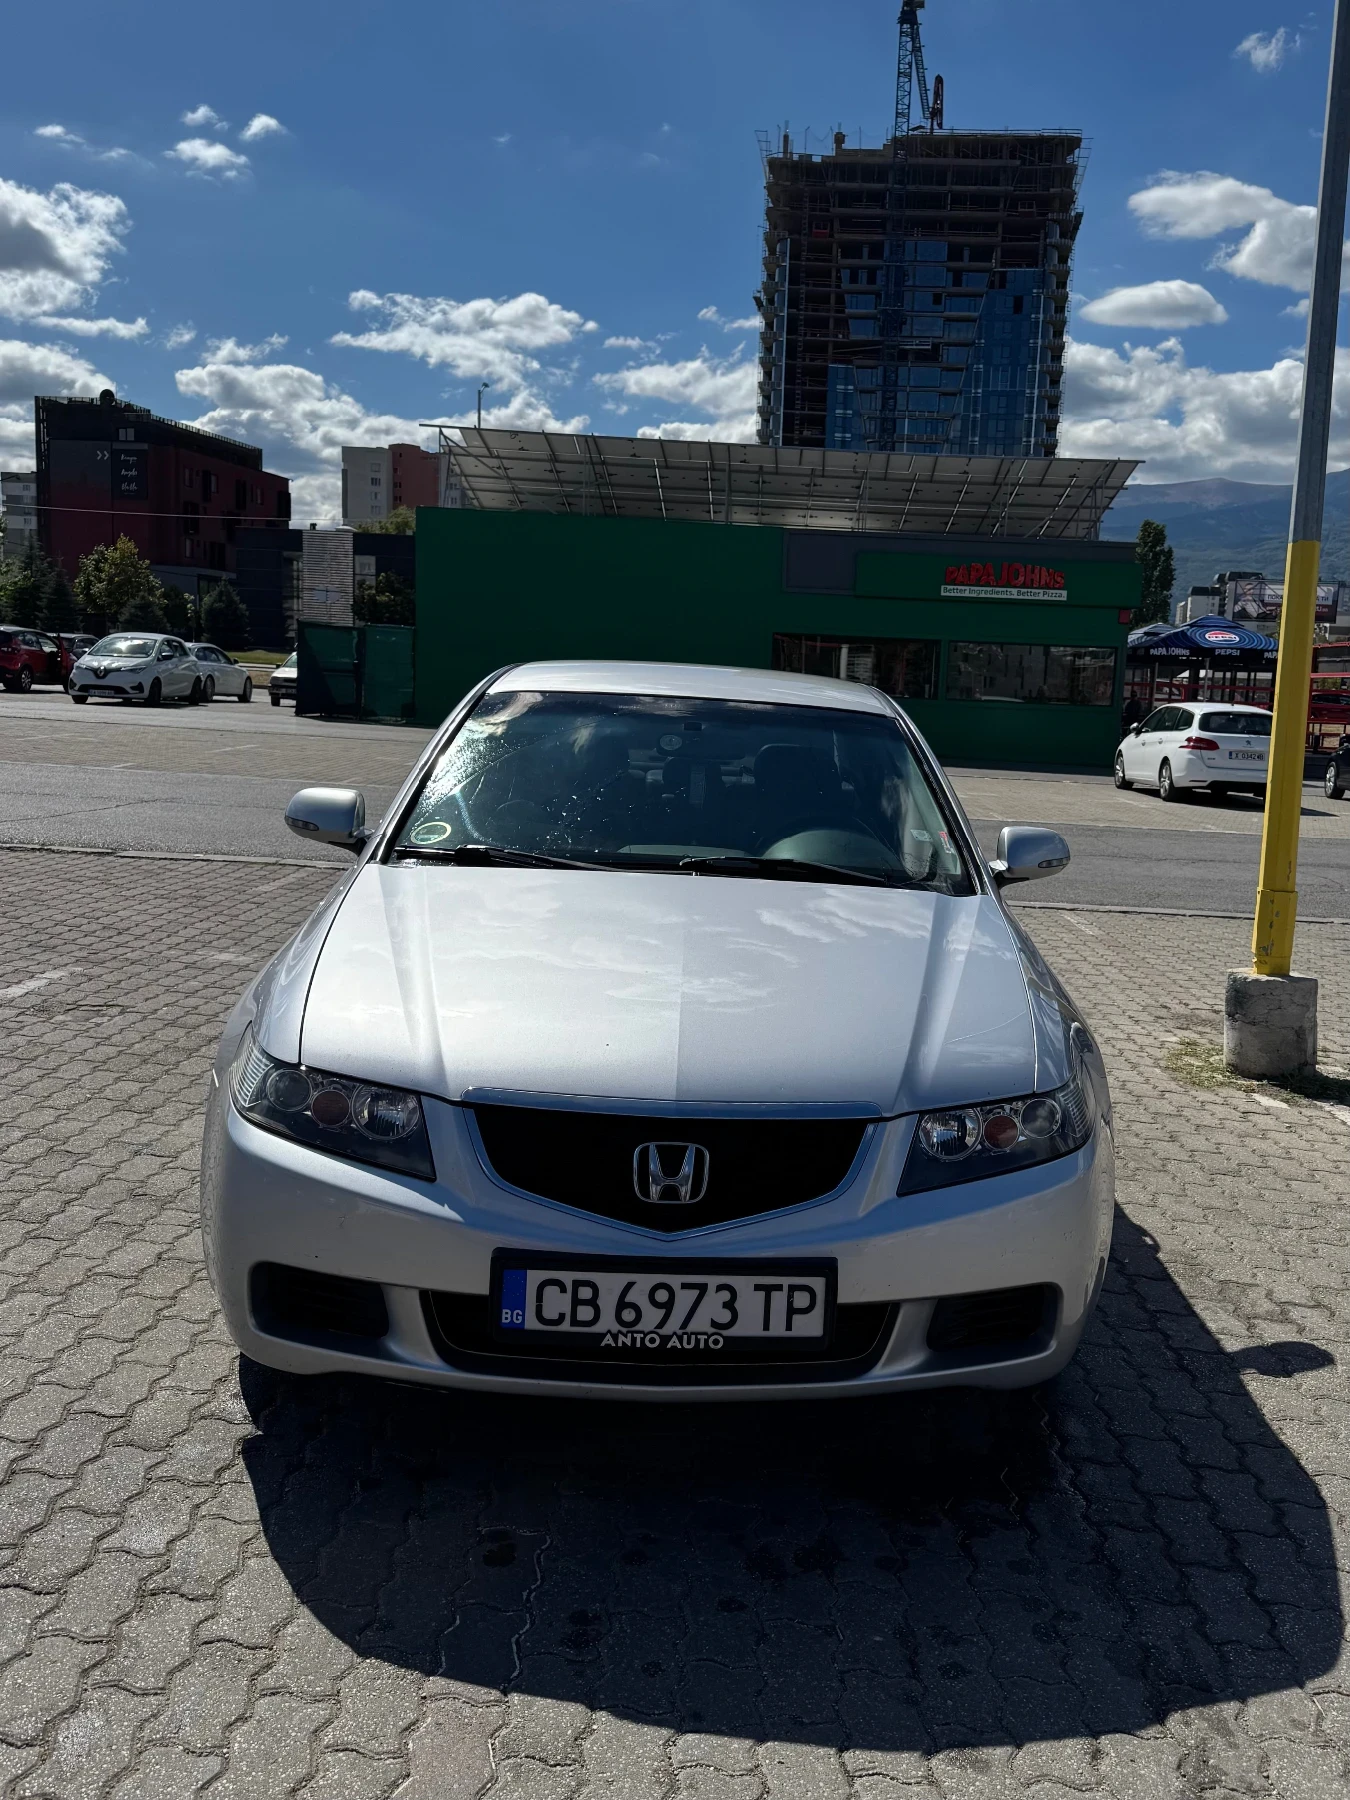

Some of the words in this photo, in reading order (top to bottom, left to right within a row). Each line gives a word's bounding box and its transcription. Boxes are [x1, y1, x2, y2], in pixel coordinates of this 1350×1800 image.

[946, 563, 996, 585] PAPA
[943, 587, 967, 595] Better
[968, 587, 1015, 597] Ingredients.
[1017, 590, 1041, 598] Better
[1042, 591, 1065, 599] Pizza.
[1149, 647, 1168, 655] PAPA
[1215, 648, 1240, 656] PEPSI
[535, 1278, 601, 1327] CB
[614, 1281, 739, 1331] 6973
[753, 1283, 817, 1332] TP
[501, 1309, 523, 1324] BG
[600, 1332, 660, 1349] ANTO
[666, 1333, 724, 1350] AUTO
